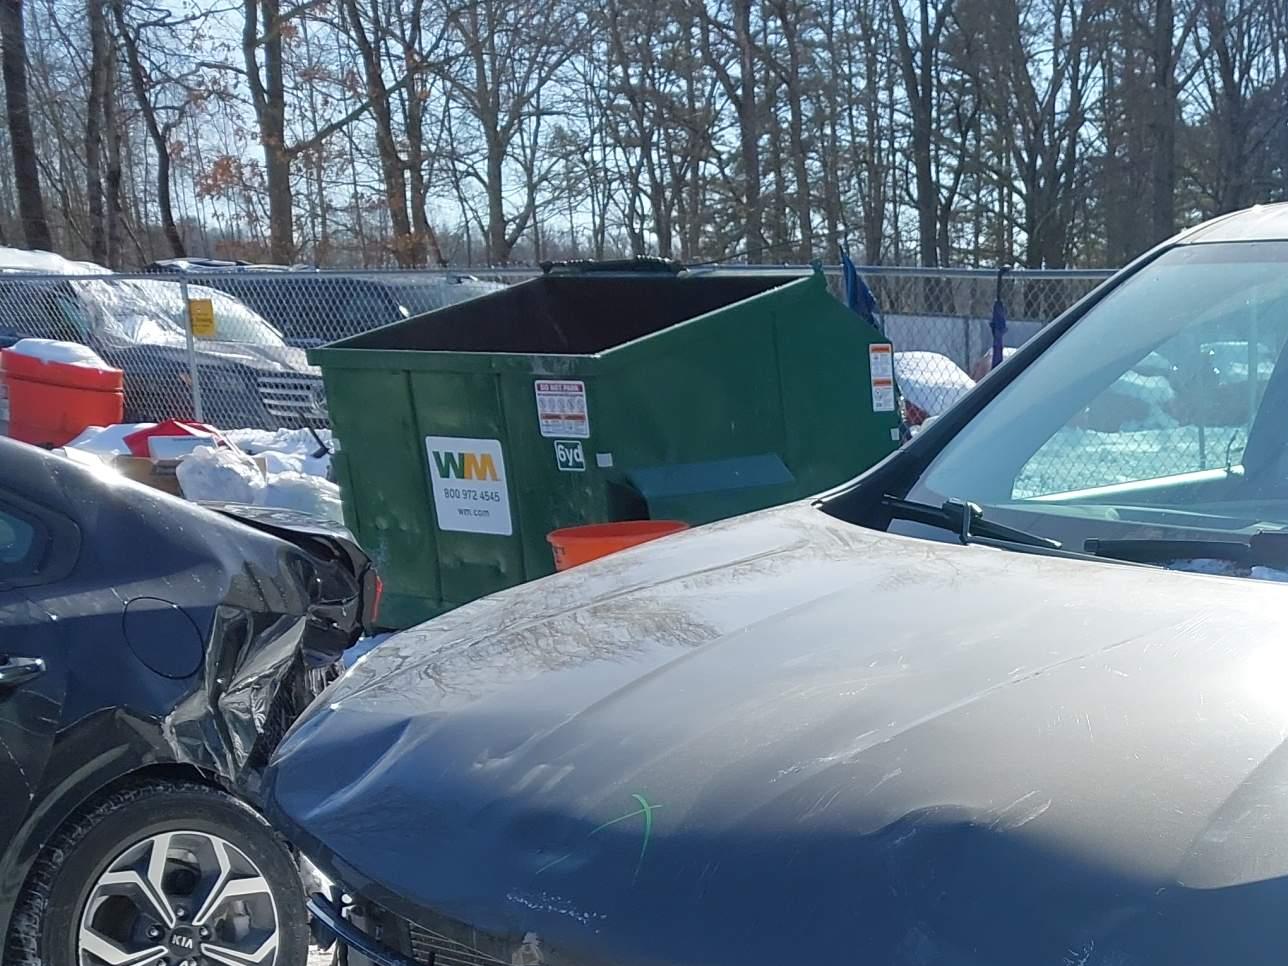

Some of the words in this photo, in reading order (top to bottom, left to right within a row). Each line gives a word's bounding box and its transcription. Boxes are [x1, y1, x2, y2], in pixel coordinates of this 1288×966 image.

[557, 444, 585, 467] 6yd
[432, 450, 501, 481] WM
[443, 487, 460, 499] 800
[462, 489, 478, 501] 972
[479, 490, 501, 502] 4545
[457, 508, 490, 517] wm.com
[171, 934, 193, 949] KIA
